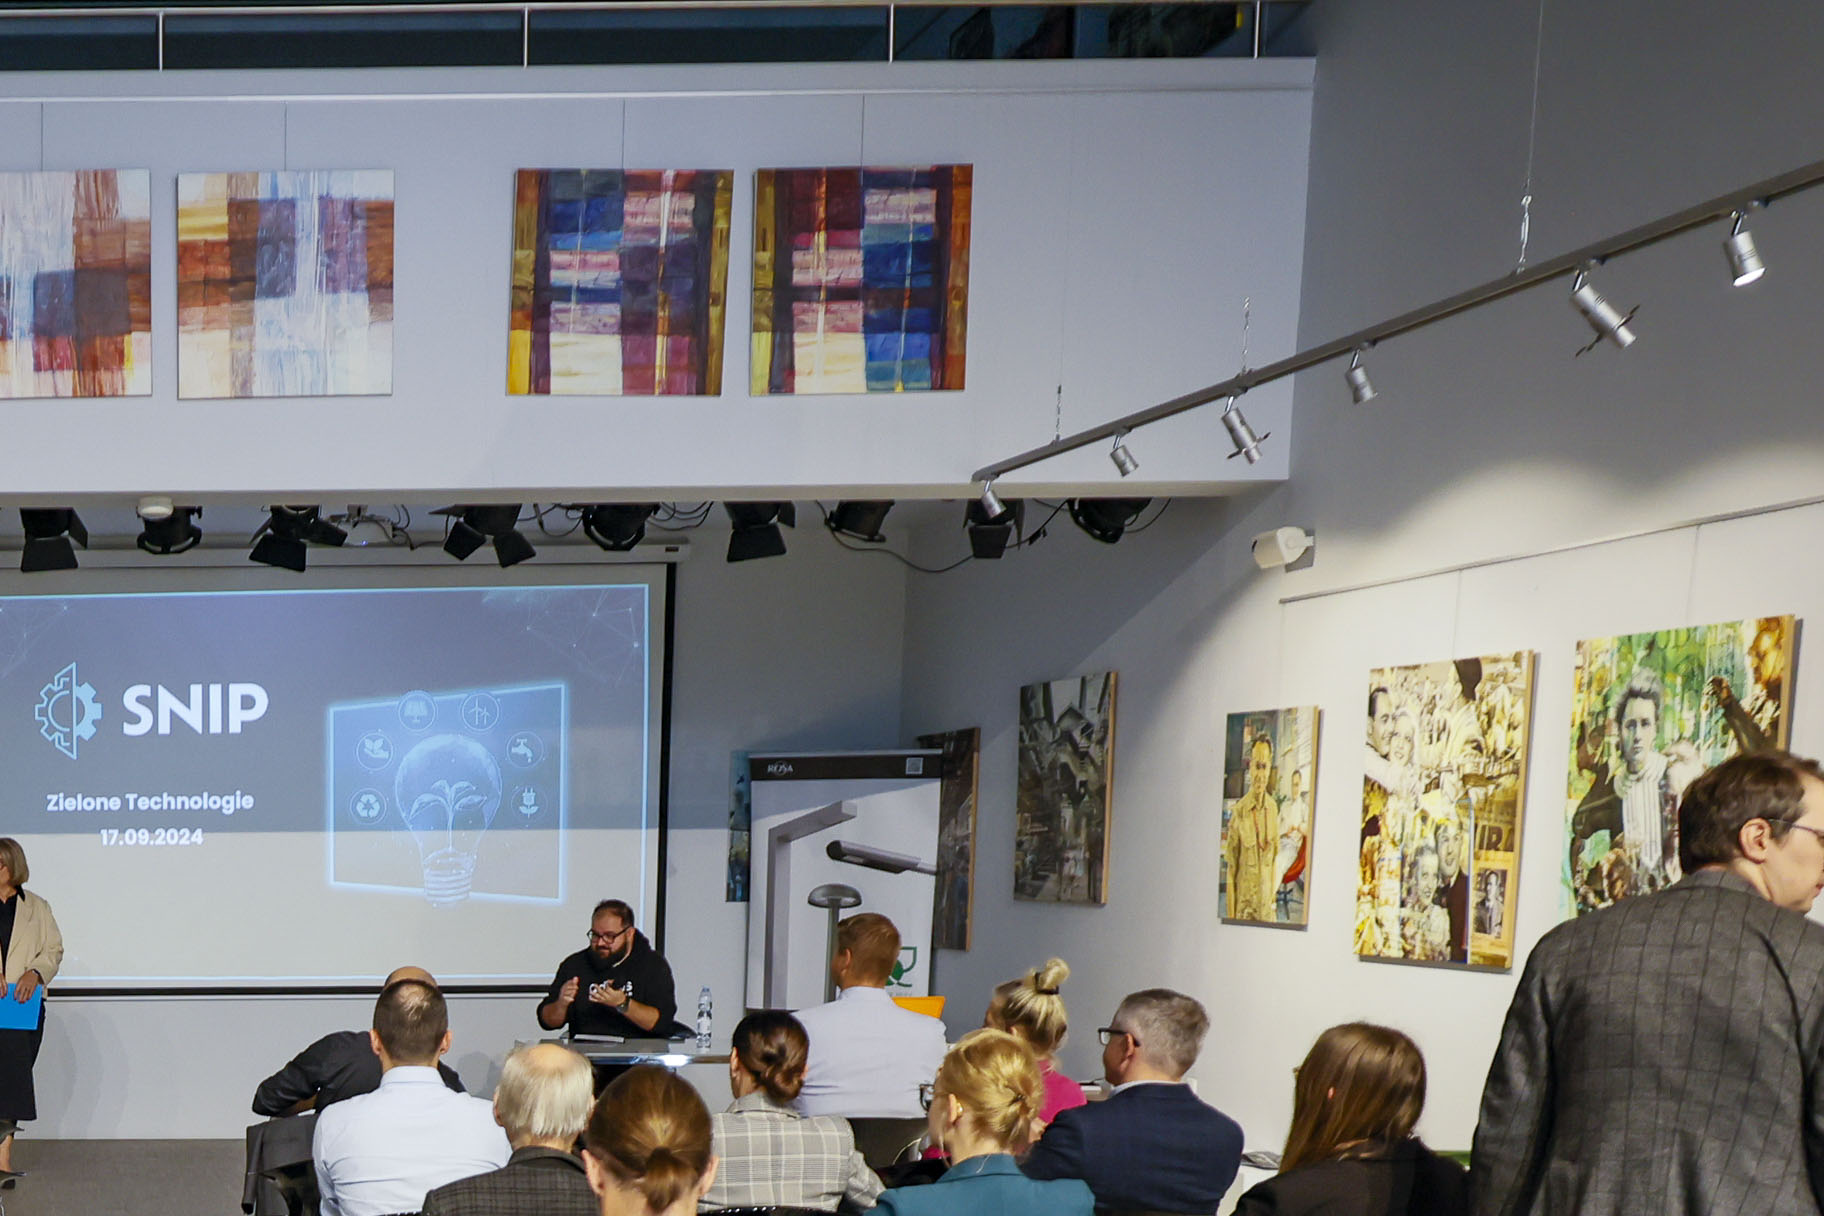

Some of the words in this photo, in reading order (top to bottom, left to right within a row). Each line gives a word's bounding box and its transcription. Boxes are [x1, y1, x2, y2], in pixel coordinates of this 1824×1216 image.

[123, 683, 269, 736] SNIP
[46, 793, 122, 812] Zielone
[125, 790, 255, 815] Technologie
[100, 828, 203, 845] 17.09.2024
